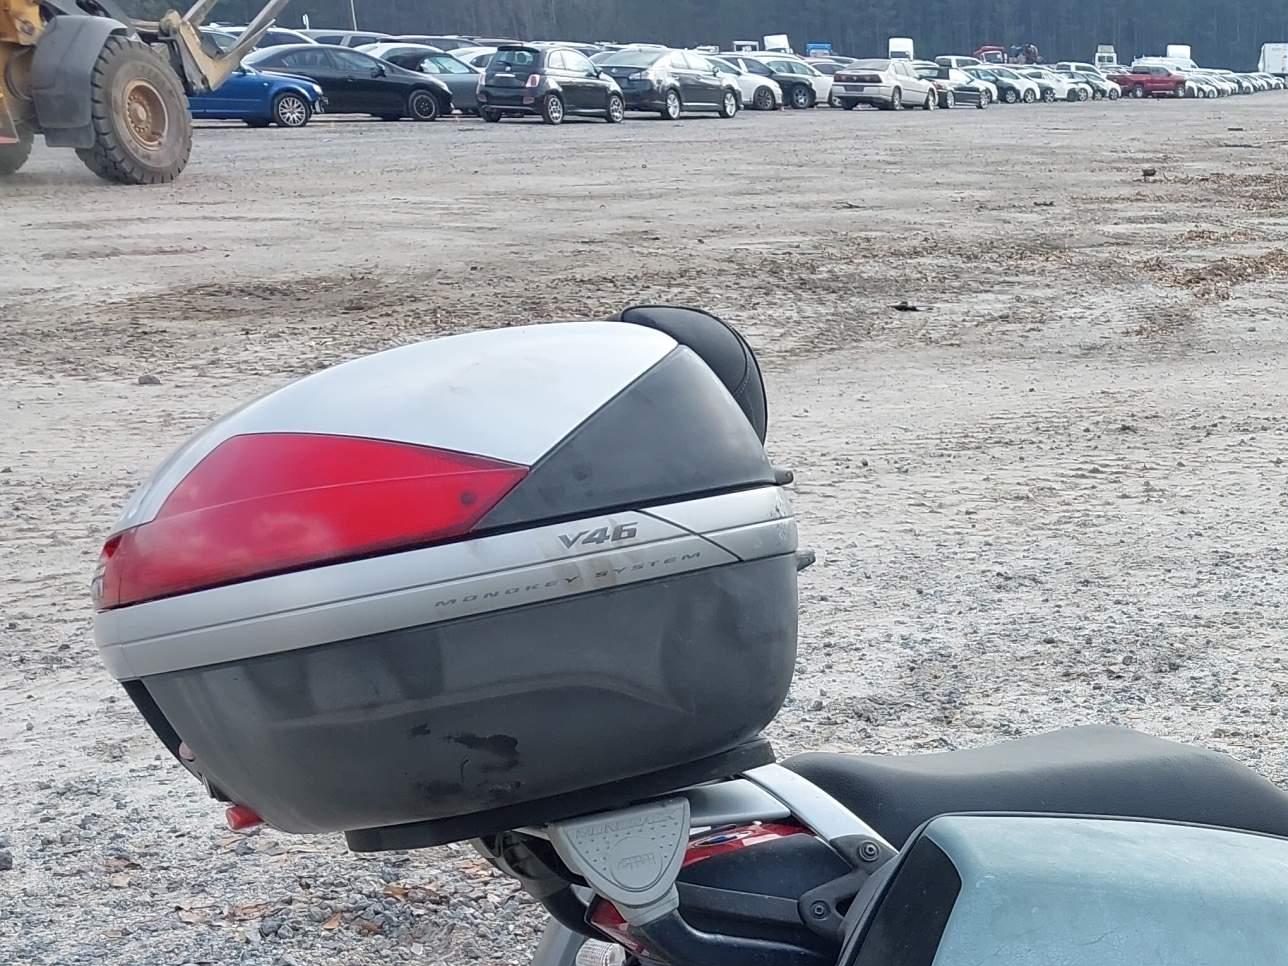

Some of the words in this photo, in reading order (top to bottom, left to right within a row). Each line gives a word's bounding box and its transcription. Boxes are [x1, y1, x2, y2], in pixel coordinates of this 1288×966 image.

[557, 521, 640, 550] V46
[434, 574, 581, 608] MONOKEY
[594, 551, 702, 579] SYSTEM
